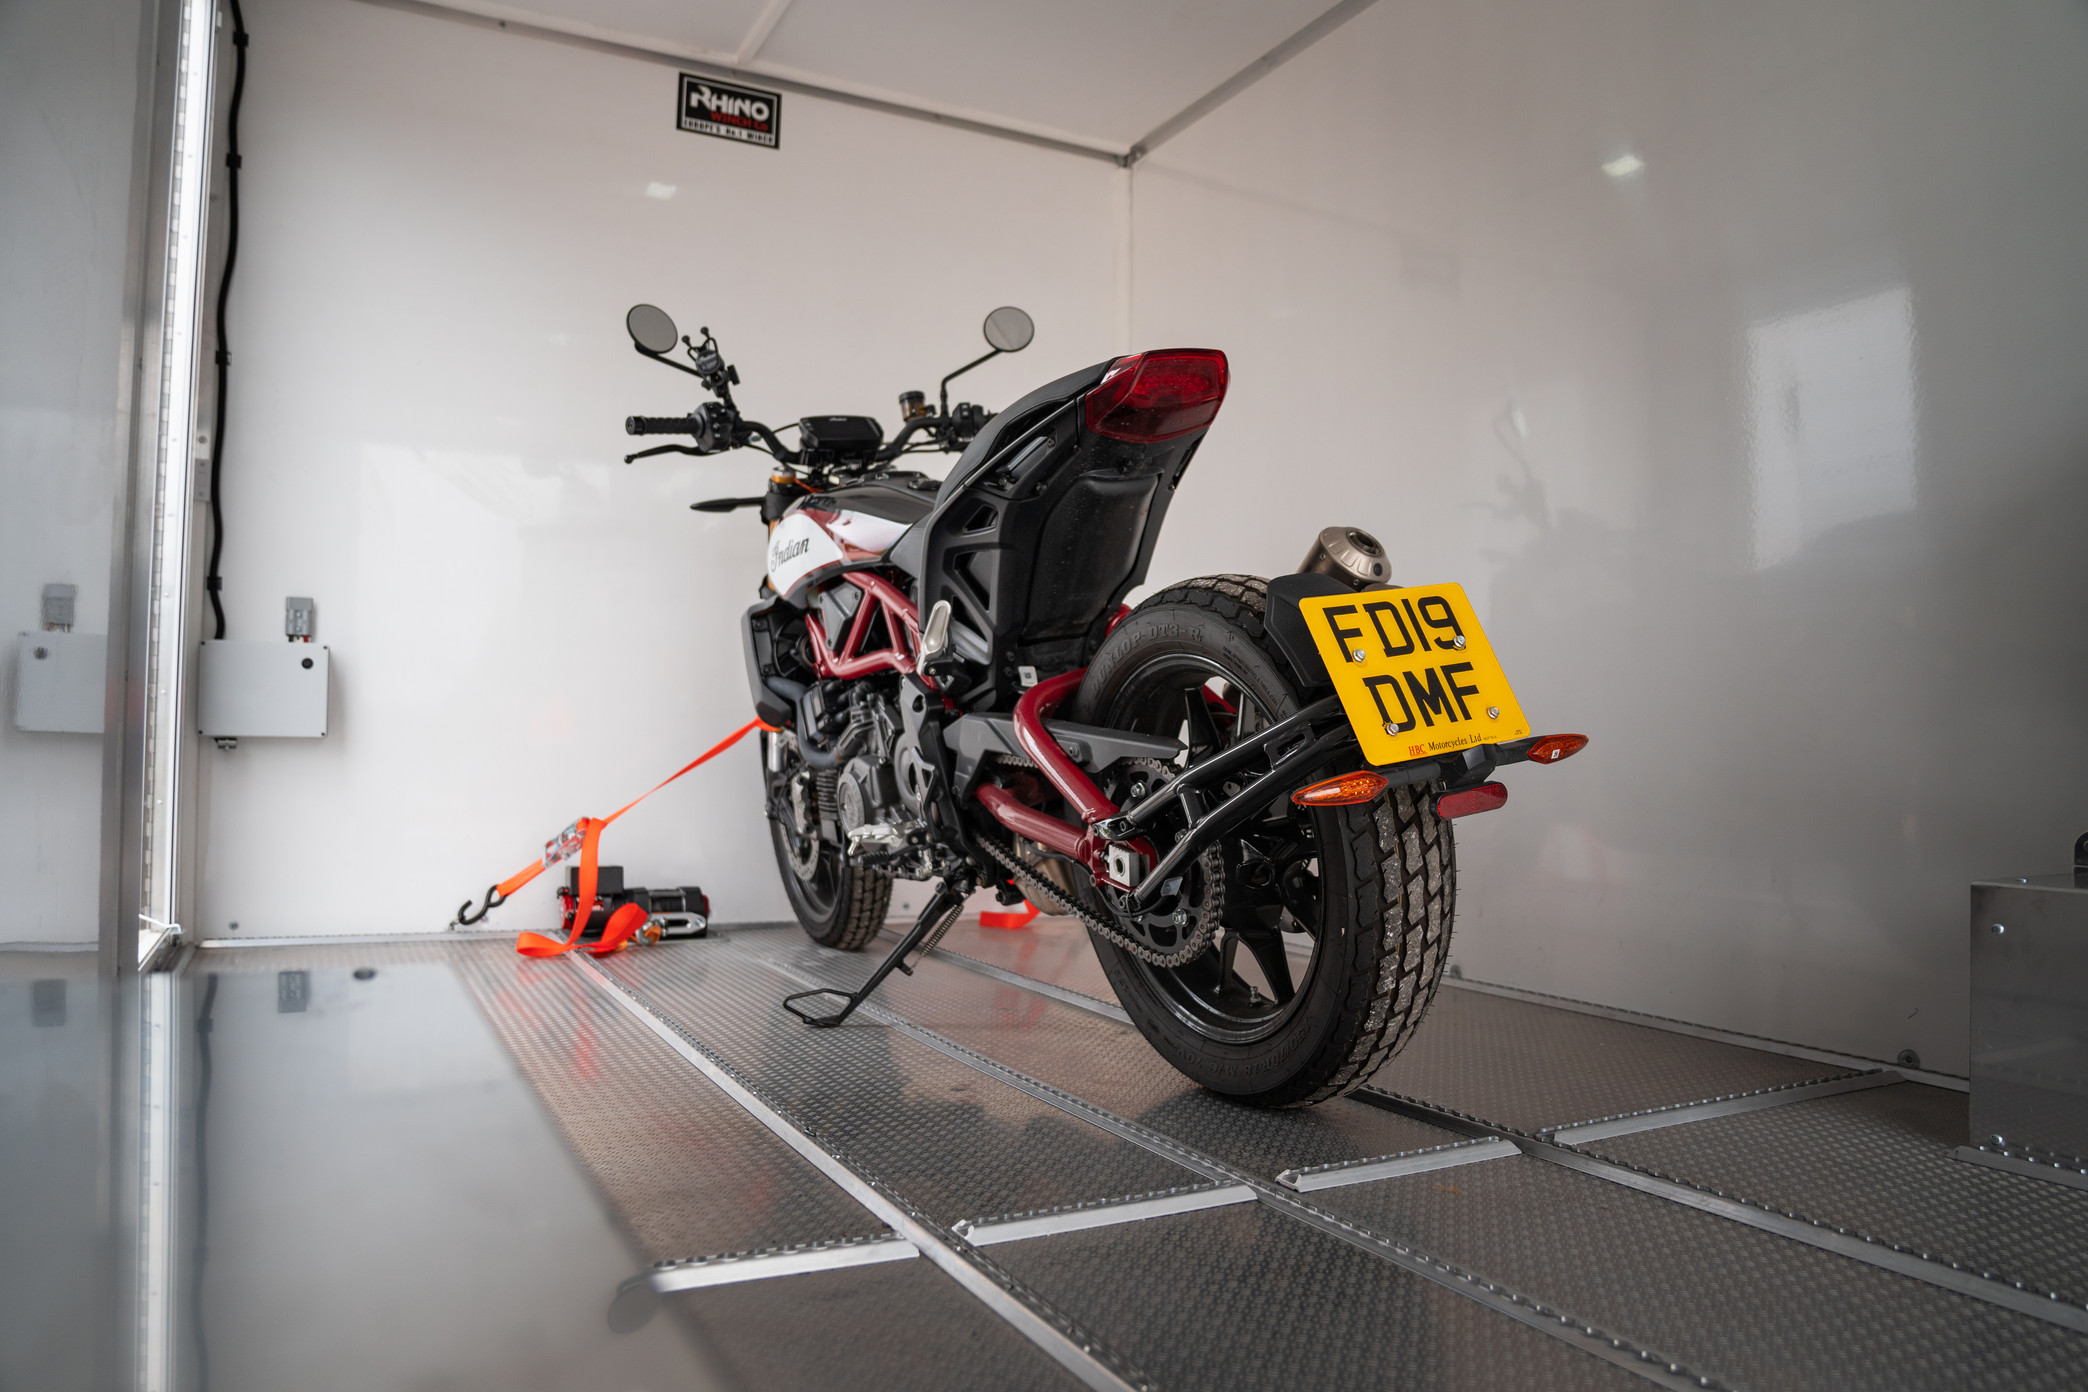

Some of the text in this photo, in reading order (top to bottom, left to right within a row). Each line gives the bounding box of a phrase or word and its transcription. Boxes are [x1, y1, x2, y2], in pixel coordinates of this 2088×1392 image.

[689, 84, 770, 122] RHINO
[710, 111, 752, 129] WINCH
[771, 537, 809, 573] Indian
[1322, 595, 1467, 663] FD19
[1362, 661, 1480, 735] DMF
[1408, 744, 1427, 757] HBC
[1428, 737, 1468, 752] Motorcycles
[1469, 733, 1482, 744] Ltd
